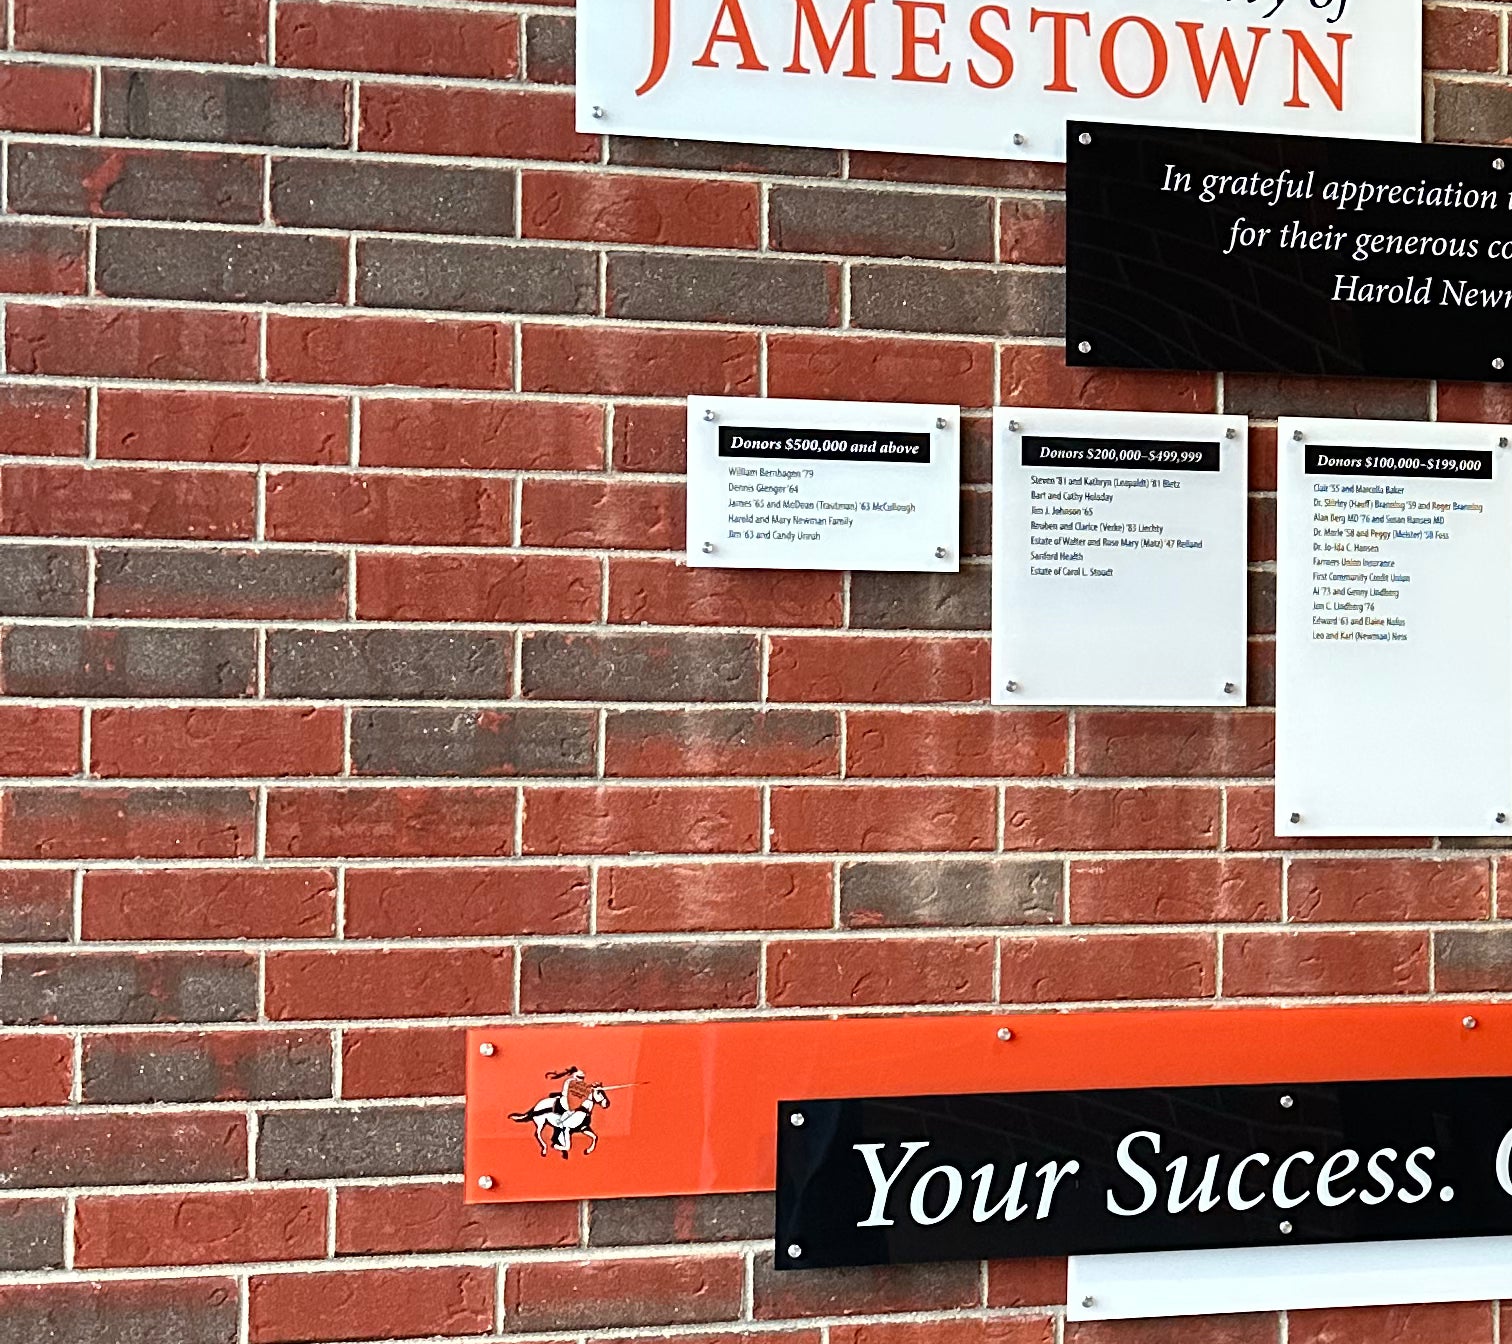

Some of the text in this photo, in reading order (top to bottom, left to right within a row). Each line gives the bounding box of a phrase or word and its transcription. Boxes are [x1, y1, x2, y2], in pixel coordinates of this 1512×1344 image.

[1160, 164, 1191, 191] In
[1198, 169, 1314, 206] grateful
[1322, 180, 1497, 210] appreciation
[1222, 217, 1271, 254] for
[1280, 220, 1347, 250] their
[1351, 233, 1478, 261] generous
[1331, 274, 1432, 304] Harold
[730, 436, 919, 454] Donors $500,000 and above
[1039, 446, 1083, 459] Donors
[1317, 454, 1362, 467] Donors
[1341, 484, 1354, 493] and
[1048, 491, 1061, 500] and
[766, 500, 780, 508] and
[728, 514, 853, 527] Harold and Mary Newman Family
[755, 530, 770, 539] and
[1030, 535, 1052, 545] Estate
[1054, 536, 1062, 546] of
[1087, 538, 1100, 546] and
[1120, 538, 1139, 549] Mary
[1030, 551, 1083, 560] Sanford Health
[1313, 556, 1395, 567] Farmers Union Insurance
[1030, 566, 1052, 575] Estate
[1053, 566, 1062, 575] of
[1313, 572, 1327, 580] First
[1329, 572, 1367, 584] Community
[1390, 573, 1410, 582] Union
[852, 1141, 1079, 1226] Your
[1106, 1129, 1454, 1219] Success.
